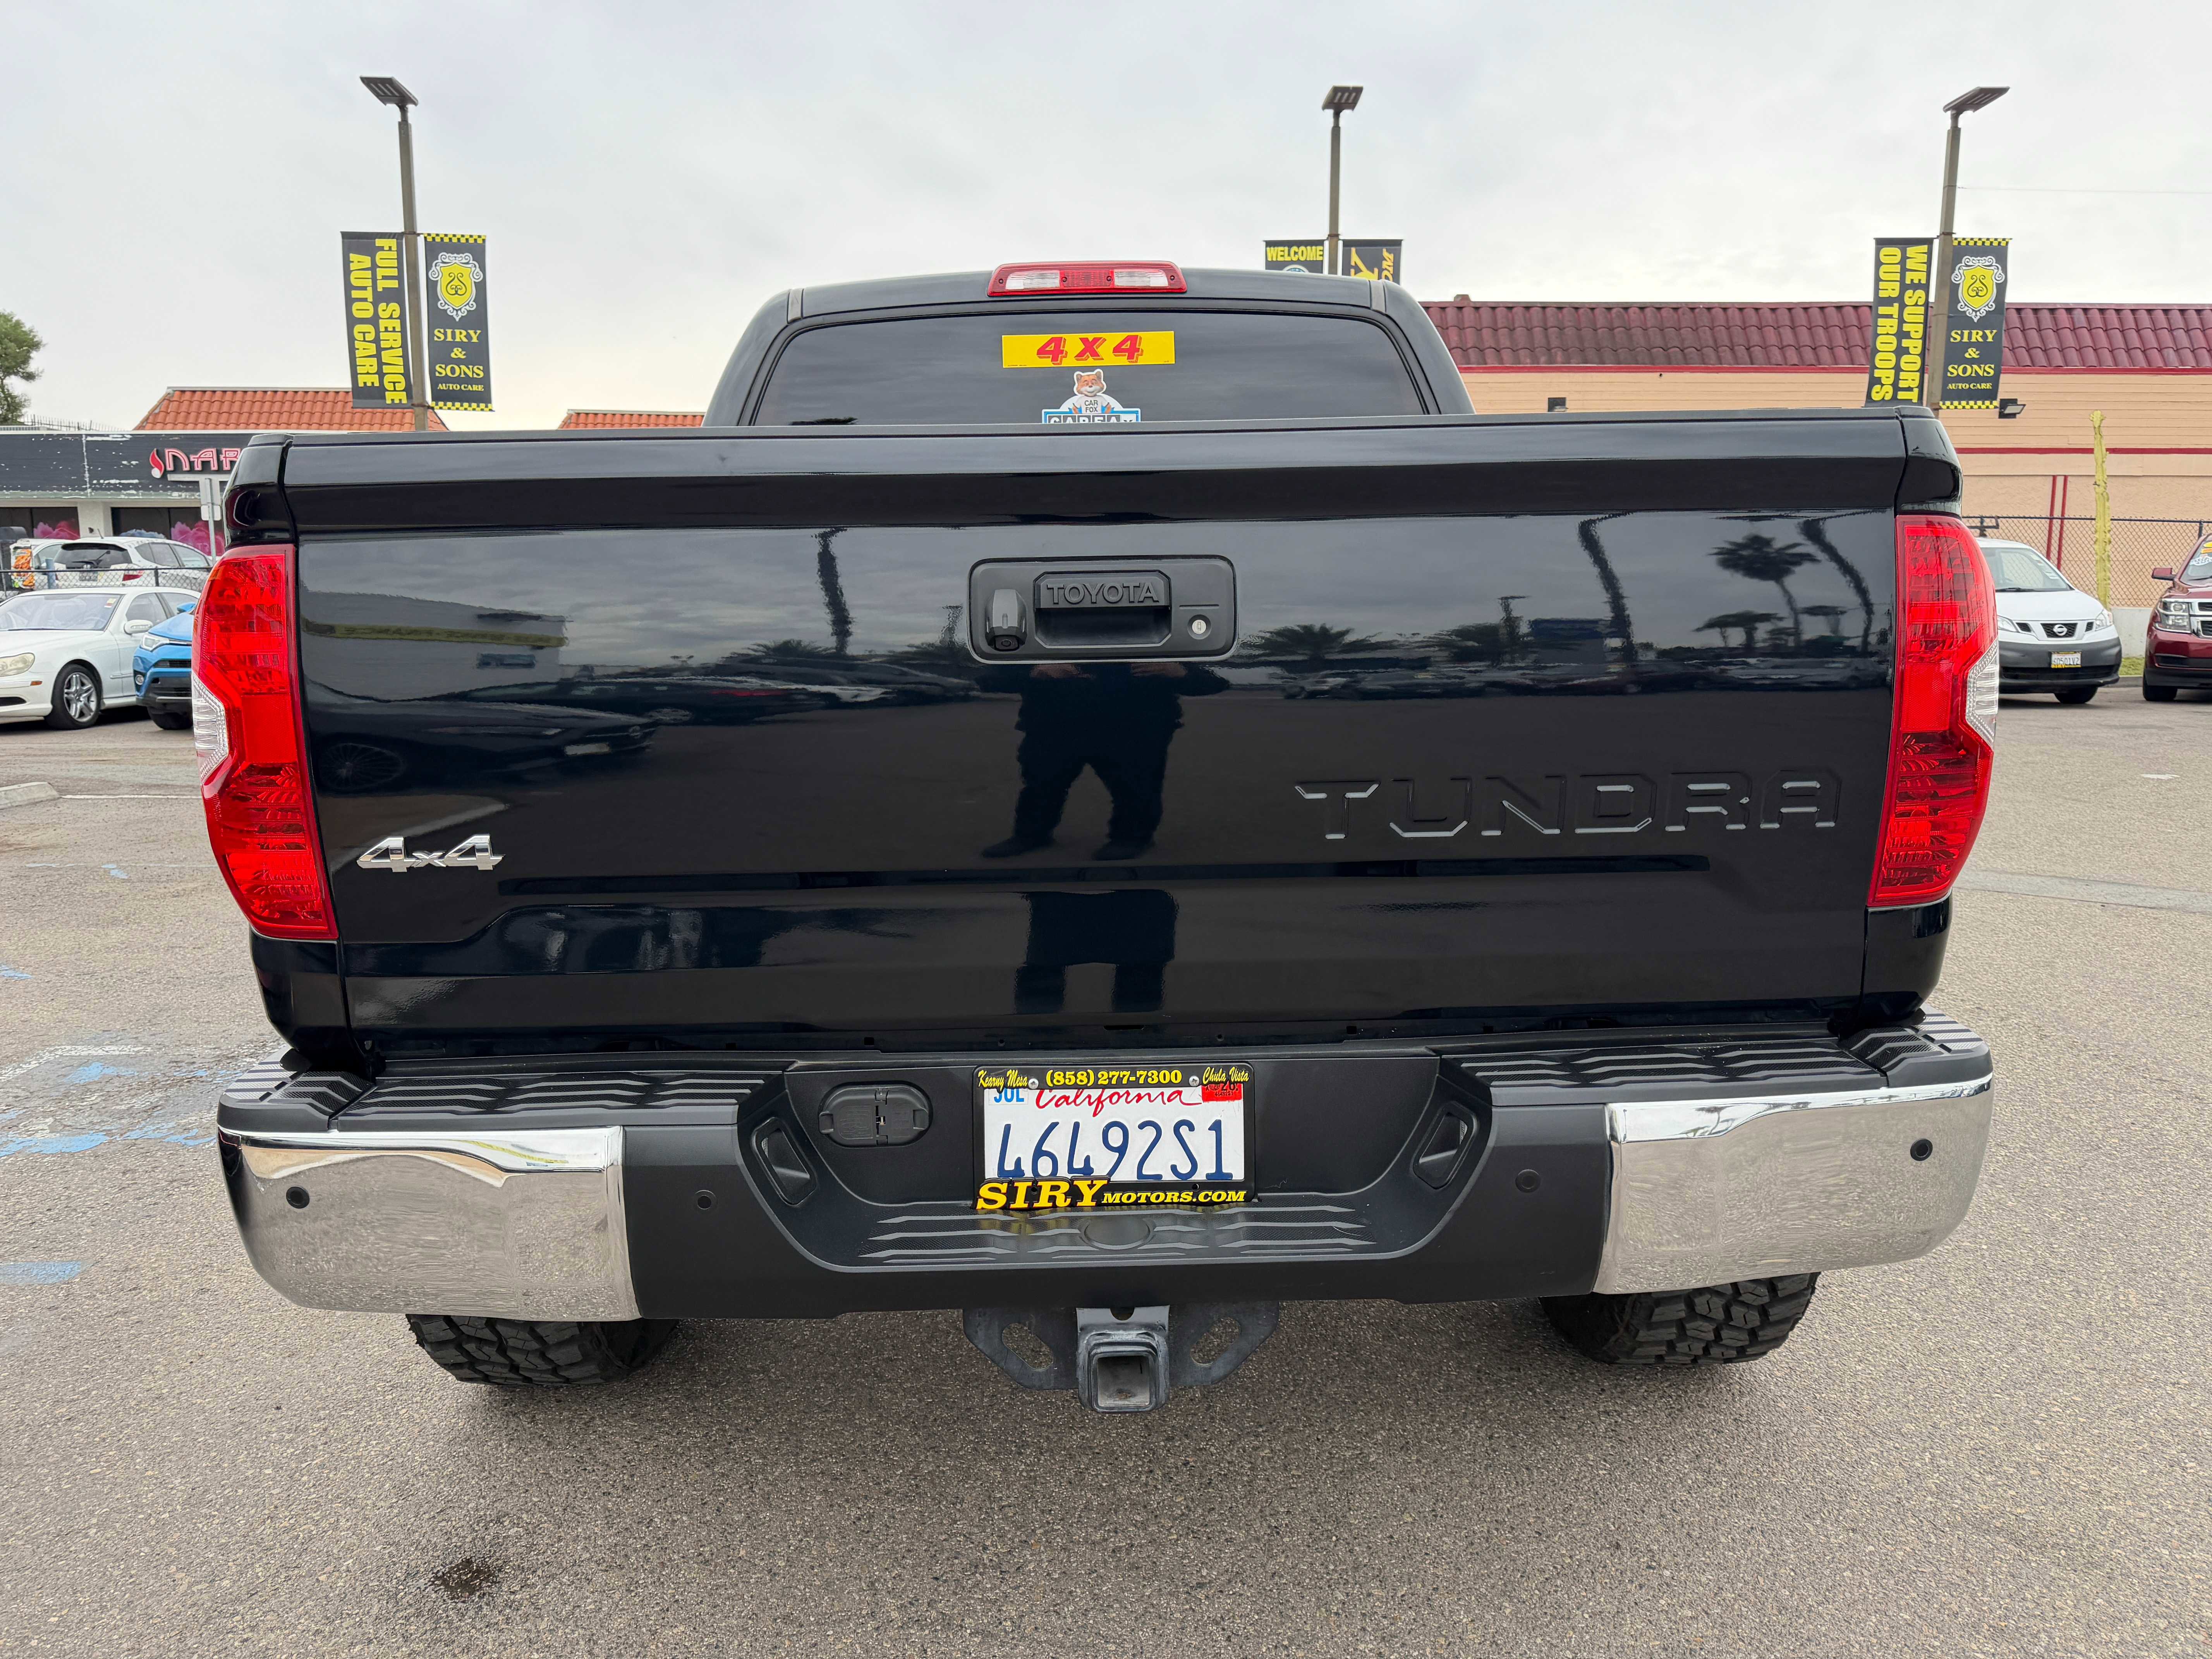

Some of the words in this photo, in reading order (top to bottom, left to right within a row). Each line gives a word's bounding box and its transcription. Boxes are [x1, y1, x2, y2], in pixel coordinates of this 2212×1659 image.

[375, 239, 398, 291] FULL
[1266, 246, 1323, 261] WELCOME
[1905, 245, 1928, 284] WE
[349, 253, 374, 318] AUTO
[1878, 247, 1901, 298] OUR
[434, 328, 481, 343] SIRY
[1898, 289, 1925, 403] SUPPORT
[1950, 330, 1997, 342] SIRY
[353, 324, 379, 387] CARE
[378, 302, 407, 404] SERVICE
[450, 348, 466, 359] &
[1871, 303, 1899, 401] TROOPS
[1964, 348, 1980, 359] &
[435, 364, 484, 378] SONS
[1947, 364, 1994, 377] SONS
[1047, 582, 1159, 604] TOYOTA
[1295, 770, 1841, 839] TUNDRA
[356, 834, 506, 872] 4x4
[978, 1070, 1005, 1091] Kearny
[1007, 1069, 1028, 1087] Mesa
[1046, 1070, 1094, 1087] (858)
[1097, 1069, 1182, 1085] 277-7300
[1203, 1067, 1227, 1084] Chula
[1230, 1066, 1249, 1082] Vista
[1035, 1089, 1202, 1117] California
[997, 1119, 1233, 1180] 46492S1
[976, 1180, 1108, 1210] SIRY
[1101, 1190, 1246, 1204] MOTORS.COM
